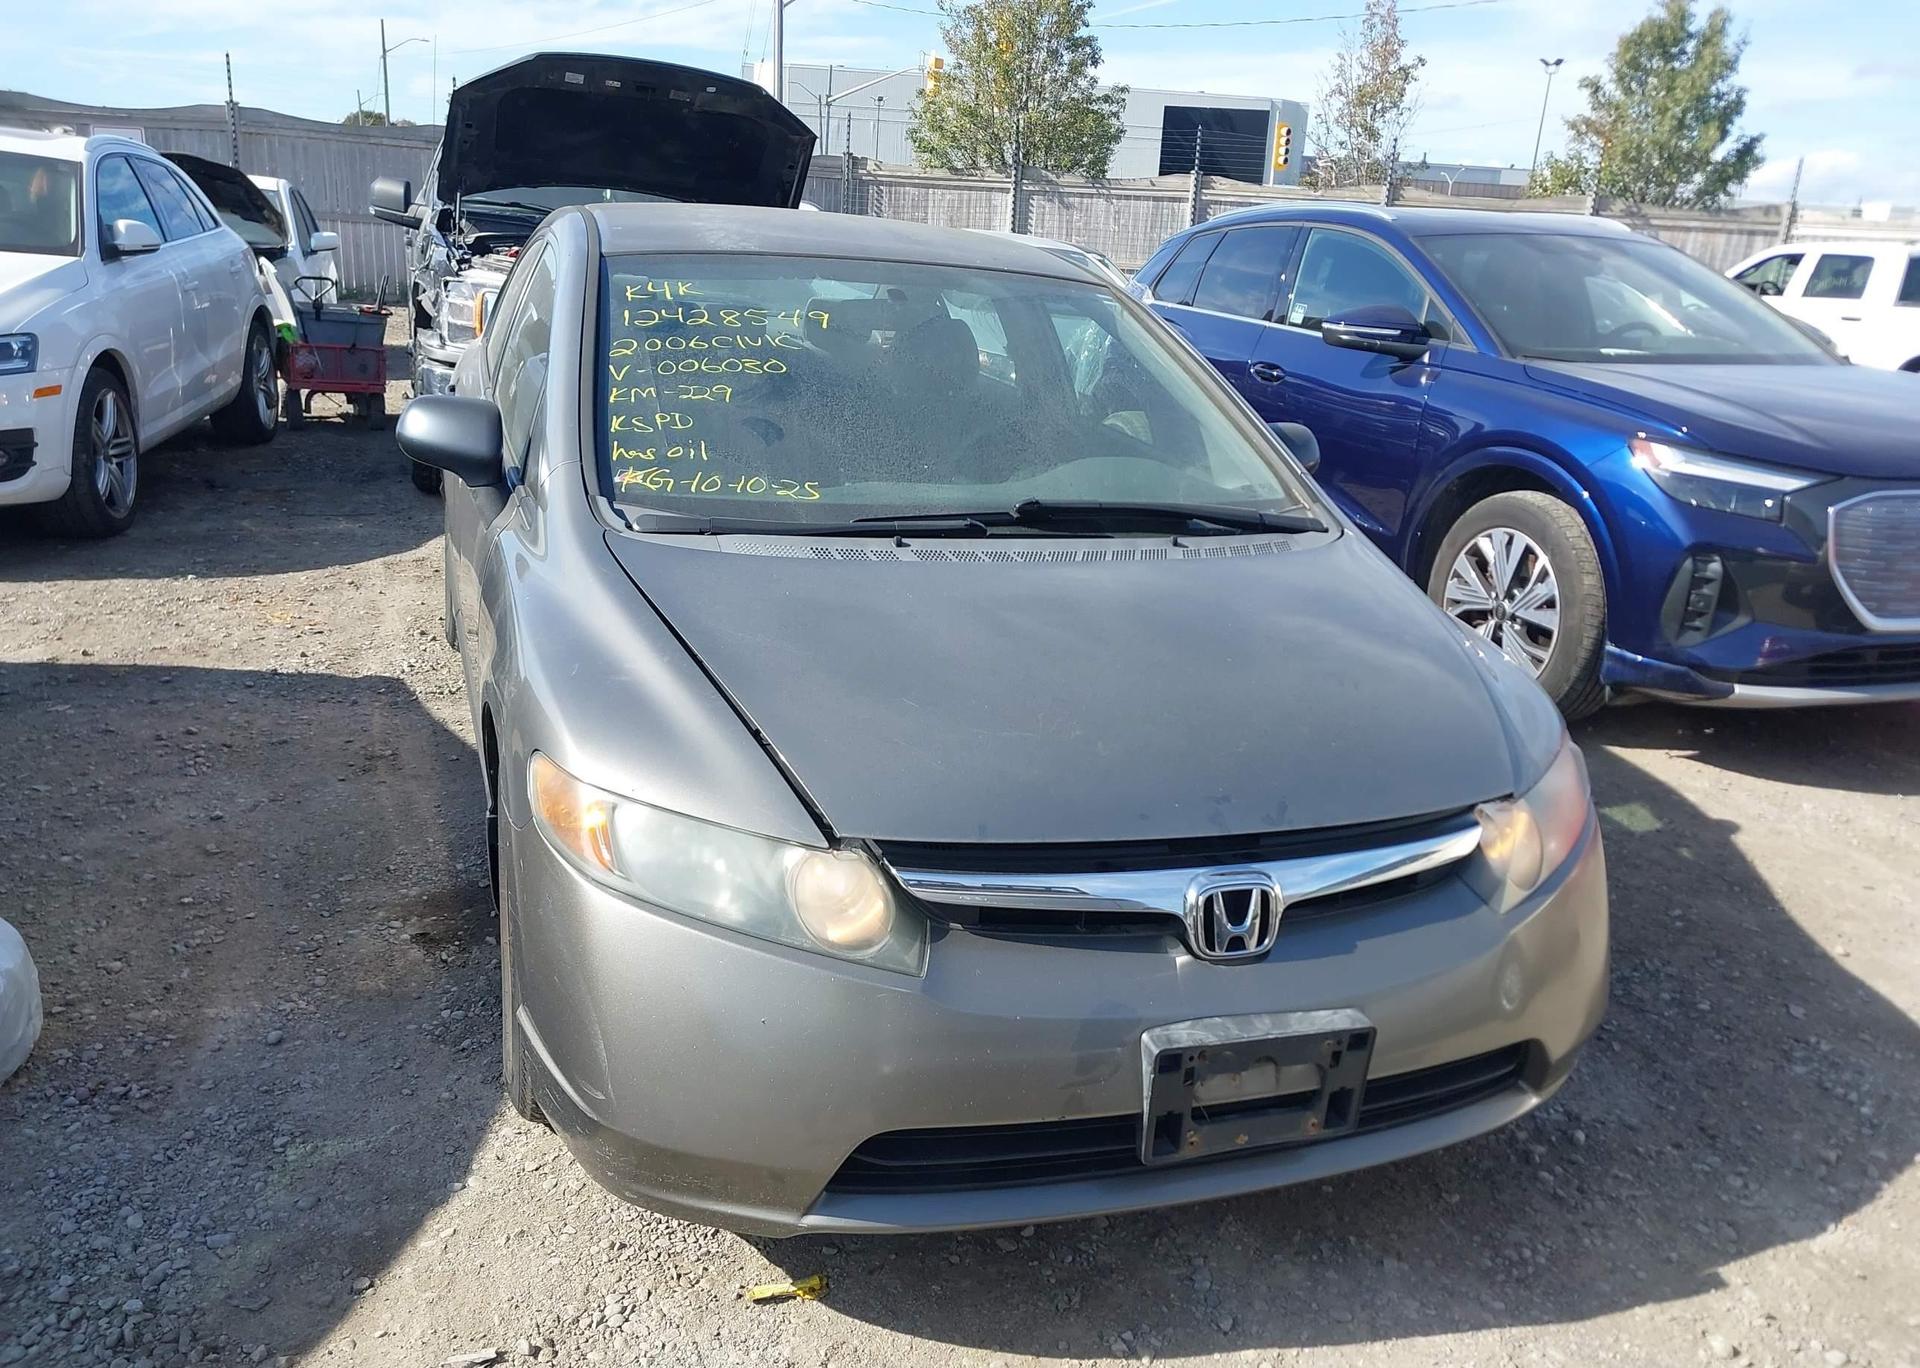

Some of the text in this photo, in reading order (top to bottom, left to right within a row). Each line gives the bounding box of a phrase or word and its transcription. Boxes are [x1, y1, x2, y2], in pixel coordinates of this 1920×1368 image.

[625, 281, 704, 301] K4K
[623, 307, 830, 329] 12428549
[611, 412, 693, 432] KSPD
[612, 439, 708, 461] has oil
